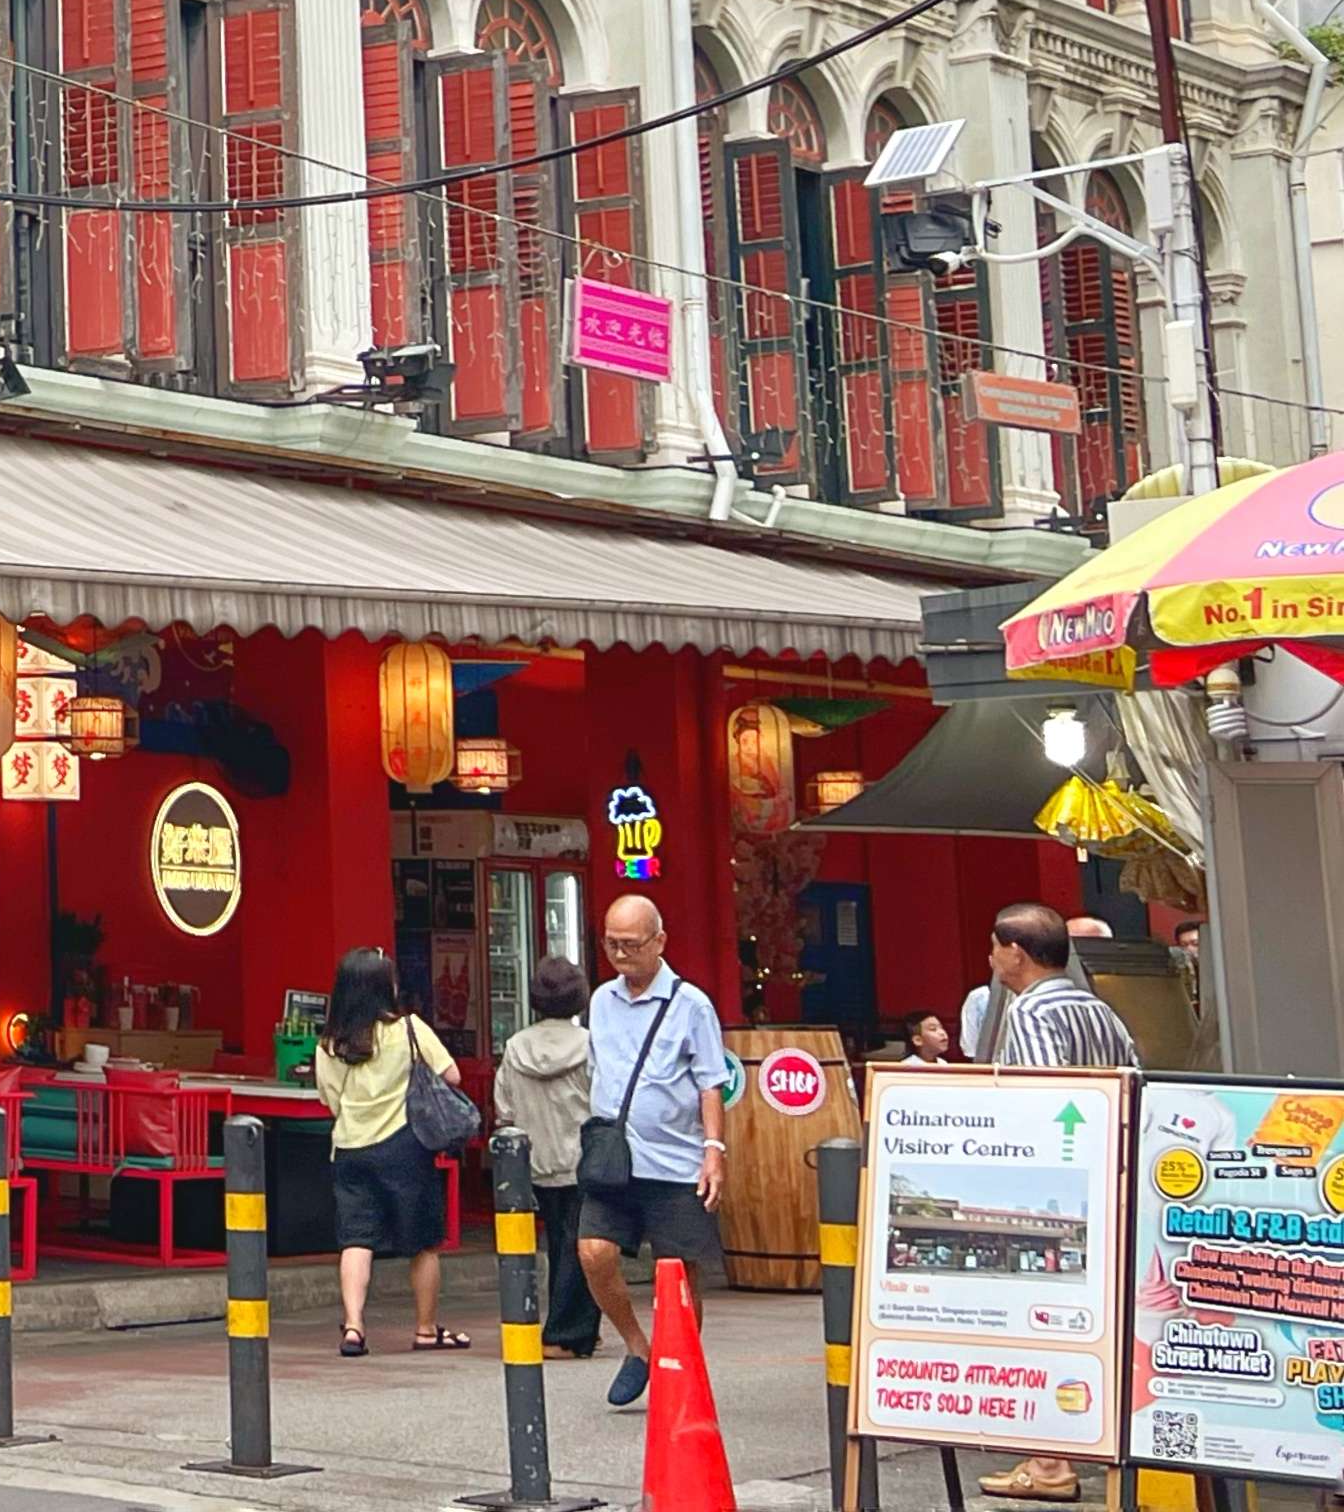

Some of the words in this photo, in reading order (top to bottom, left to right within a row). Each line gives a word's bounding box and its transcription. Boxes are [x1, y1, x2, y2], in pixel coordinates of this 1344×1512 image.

[1202, 586, 1264, 626] No.1
[1271, 598, 1299, 619] in
[885, 1109, 996, 1129] Chinatown
[884, 1136, 953, 1157] Visitor
[962, 1138, 1036, 1159] Centre
[1167, 1206, 1230, 1236] Retail
[1232, 1210, 1253, 1239] &
[1255, 1212, 1304, 1241] F&B
[1306, 1217, 1344, 1245] sta
[1168, 1323, 1256, 1352] Chinatown
[876, 1357, 959, 1384] DISCOUNTED
[964, 1364, 1047, 1390] ATTRACTION
[1155, 1343, 1206, 1370] Street
[1208, 1349, 1269, 1375] Market
[876, 1388, 931, 1412] TICKETS
[937, 1392, 973, 1416] SOLD
[978, 1396, 1016, 1420] HERE
